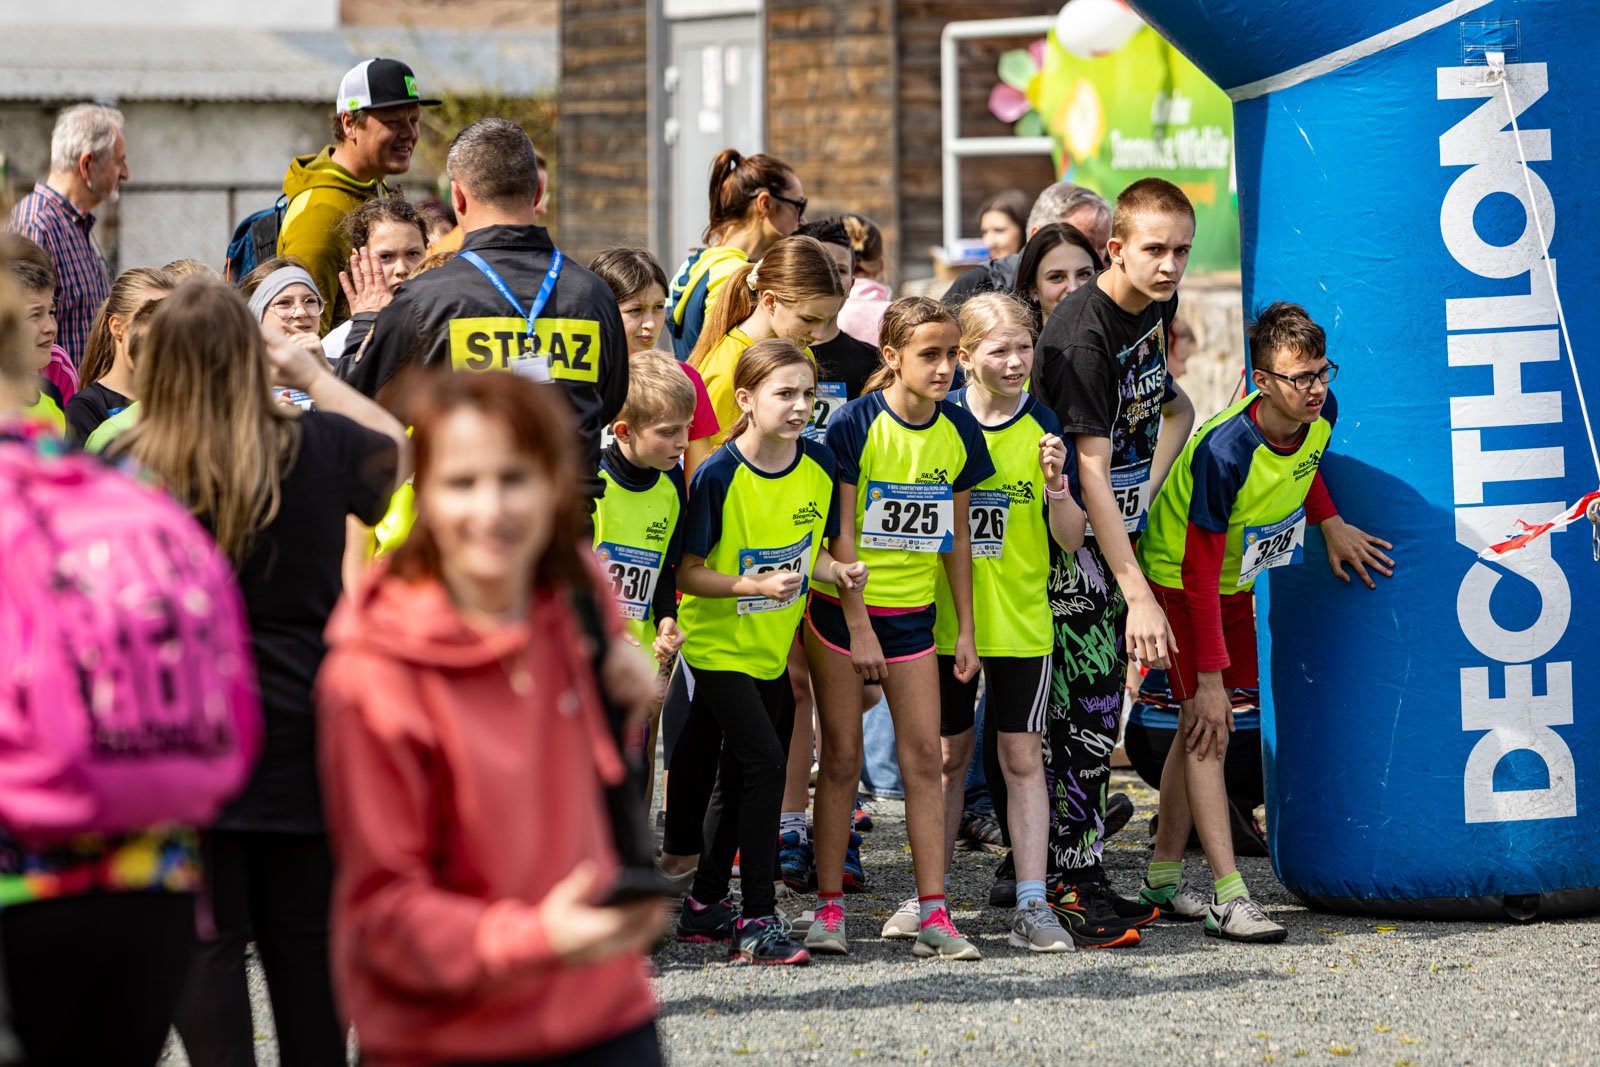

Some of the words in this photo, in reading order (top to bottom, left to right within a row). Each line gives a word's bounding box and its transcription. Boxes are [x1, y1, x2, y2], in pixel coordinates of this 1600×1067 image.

[1129, 409, 1150, 426] SINCE
[1437, 62, 1577, 823] DECATHLON
[1002, 483, 1017, 491] SKS
[881, 500, 939, 535] 325
[969, 508, 1004, 540] 26
[1254, 527, 1295, 566] 328
[607, 563, 651, 602] 330
